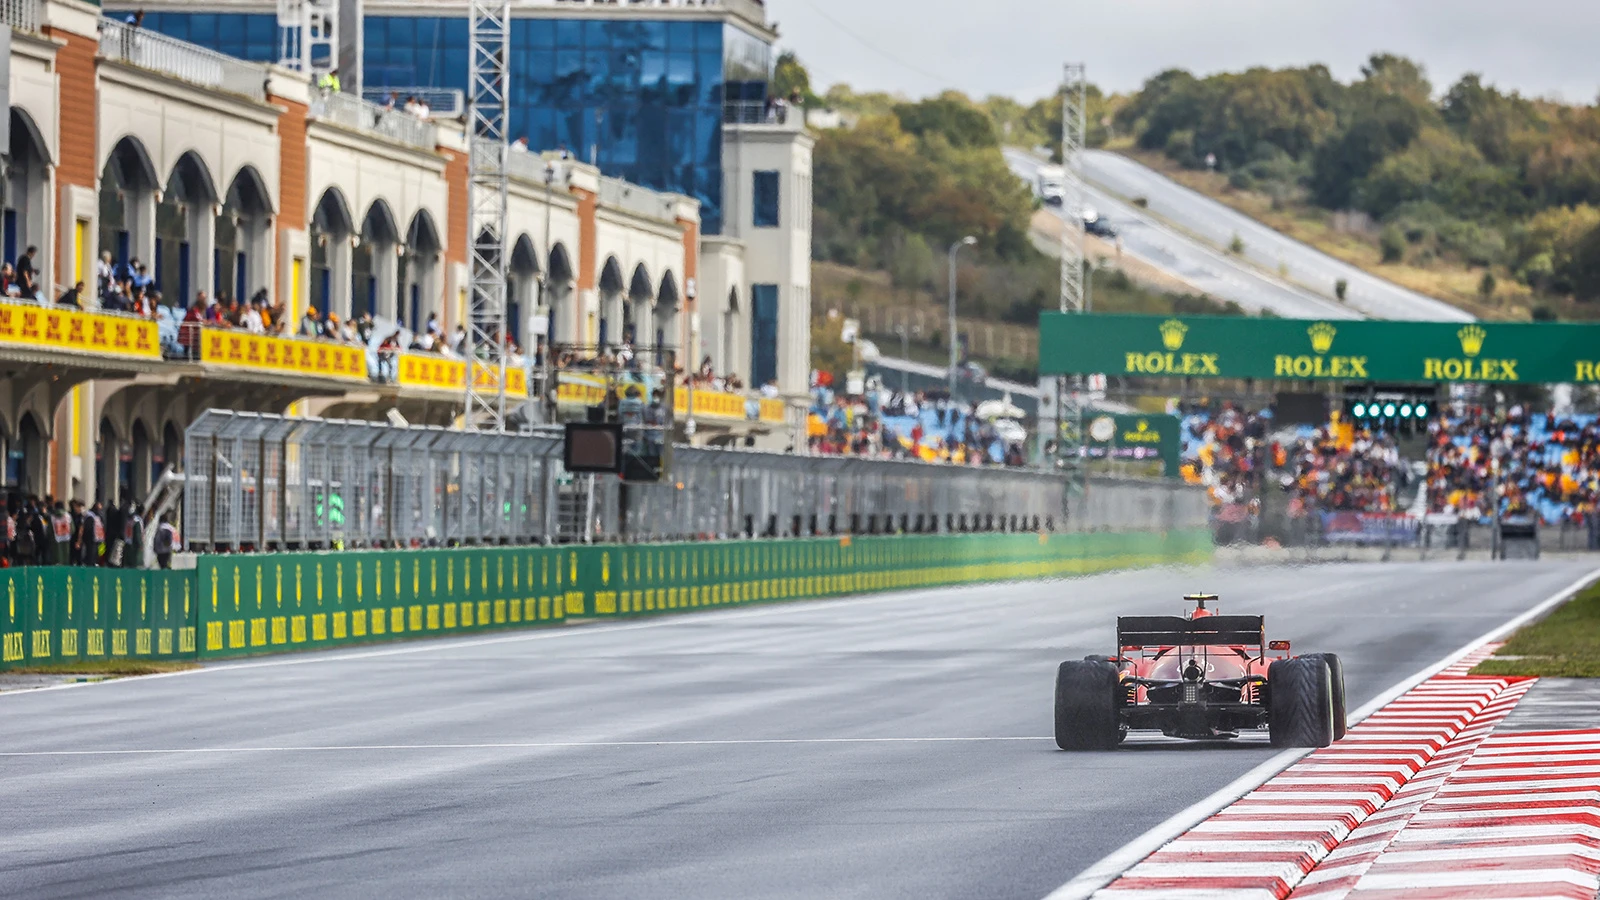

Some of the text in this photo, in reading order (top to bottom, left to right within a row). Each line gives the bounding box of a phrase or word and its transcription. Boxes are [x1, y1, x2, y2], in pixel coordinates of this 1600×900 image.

[1125, 351, 1219, 375] ROLEX
[1274, 355, 1368, 378] ROLEX
[1424, 358, 1519, 380] ROLEX
[1575, 360, 1600, 381] R
[3, 632, 24, 662] ROLEX
[32, 629, 51, 657] ROLEX
